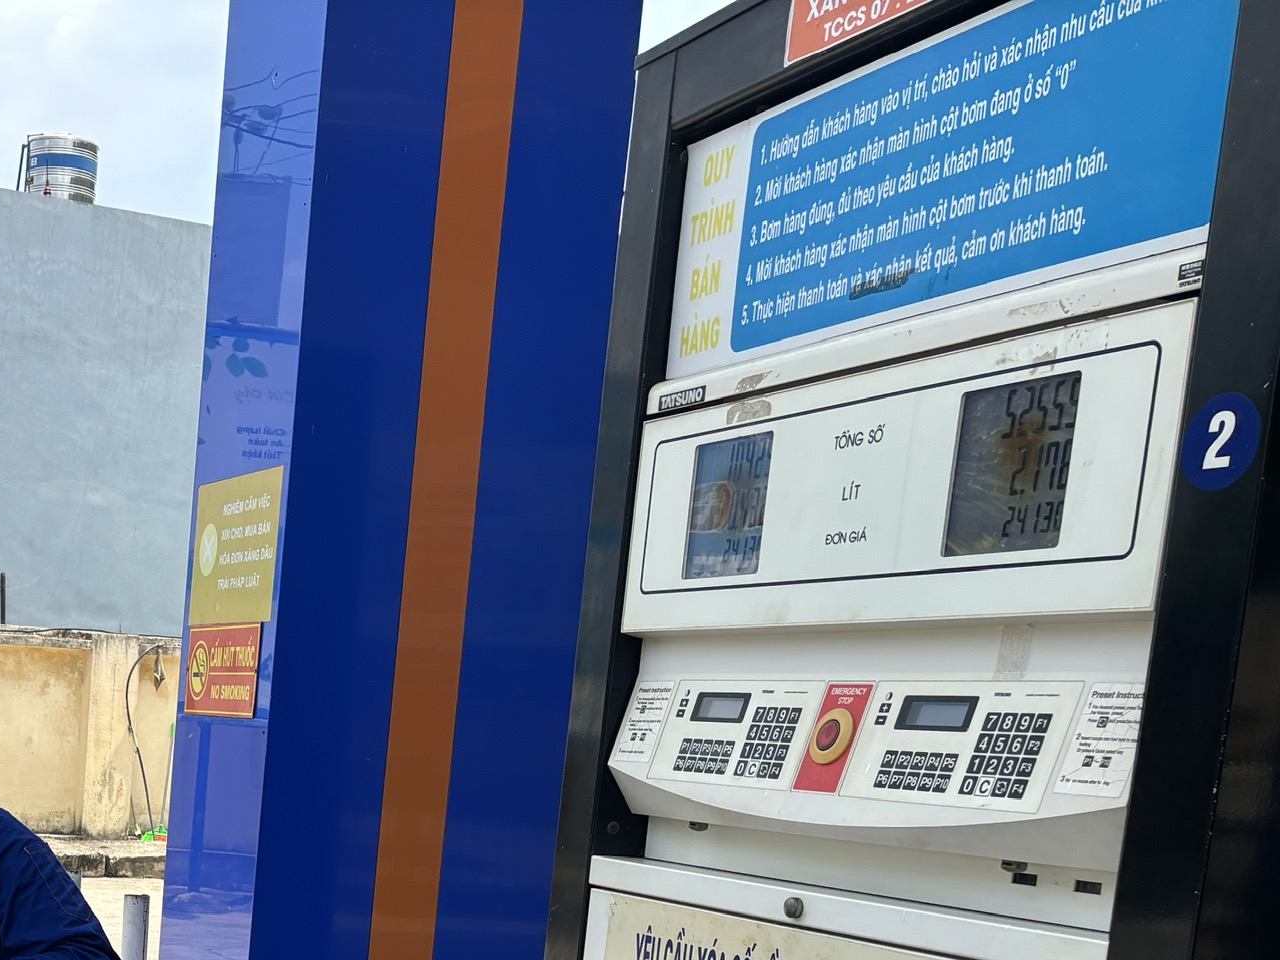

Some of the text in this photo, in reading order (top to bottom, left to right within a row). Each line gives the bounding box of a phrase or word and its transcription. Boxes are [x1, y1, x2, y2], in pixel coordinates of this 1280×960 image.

[824, 6, 866, 42] TCCS
[761, 145, 768, 166] 1.
[770, 131, 799, 162] Hướng
[802, 119, 819, 148] dẫn
[821, 107, 850, 138] khách
[853, 99, 877, 128] hàng
[881, 88, 899, 115] vào
[902, 84, 912, 110] vị
[914, 73, 928, 102] trí,
[931, 65, 959, 94] chào
[962, 51, 981, 82] hỏi
[984, 46, 997, 72] và
[1000, 37, 1022, 67] xác
[1025, 23, 1056, 58] nhận
[1060, 13, 1085, 41] nhu
[754, 184, 763, 206] 2.
[765, 178, 781, 203] Mời
[783, 165, 811, 196] khách
[813, 151, 837, 183] hàng
[840, 143, 857, 172] xác
[859, 135, 884, 166] nhận
[887, 126, 910, 152] màn
[912, 118, 937, 146] hình
[940, 108, 958, 136] cột
[961, 99, 987, 127] bơm
[990, 88, 1021, 115] đang
[1024, 73, 1035, 103] ở
[1035, 65, 1053, 99] số
[703, 145, 735, 187] QUY
[750, 135, 1015, 247] 3. Bơm hàng đúng, đủ theo yêu cầu của khách hàng.
[690, 197, 736, 247] TRÌNH
[745, 146, 1108, 286] 4. Mời khách hàng xác nhận màn hình cột bơm trước khi thanh toán.
[690, 254, 721, 301] BÁN
[741, 304, 749, 326] 5.
[752, 296, 774, 325] Thực
[775, 288, 796, 319] hiện
[798, 281, 824, 310] thanh
[826, 272, 848, 301] toán
[915, 242, 933, 274] kết
[934, 235, 957, 273] quả,
[961, 230, 986, 260] cảm
[990, 228, 1005, 252] ơn
[1008, 213, 1046, 247] khách
[1049, 204, 1086, 235] hàng.
[680, 313, 720, 358] HÀNG
[661, 388, 703, 409] TATSUNO
[834, 424, 886, 450] TỔNG SỐ
[1202, 410, 1236, 470] 2
[842, 481, 861, 501] LÍT
[825, 526, 867, 546] ĐƠN GIÁ
[210, 636, 255, 667] CẤM HÚT THUỐC
[210, 685, 250, 701] NO SMOKING
[831, 687, 868, 695] EMERGENCY
[1091, 690, 1115, 699] Preset
[987, 715, 1030, 730] 7 8 9
